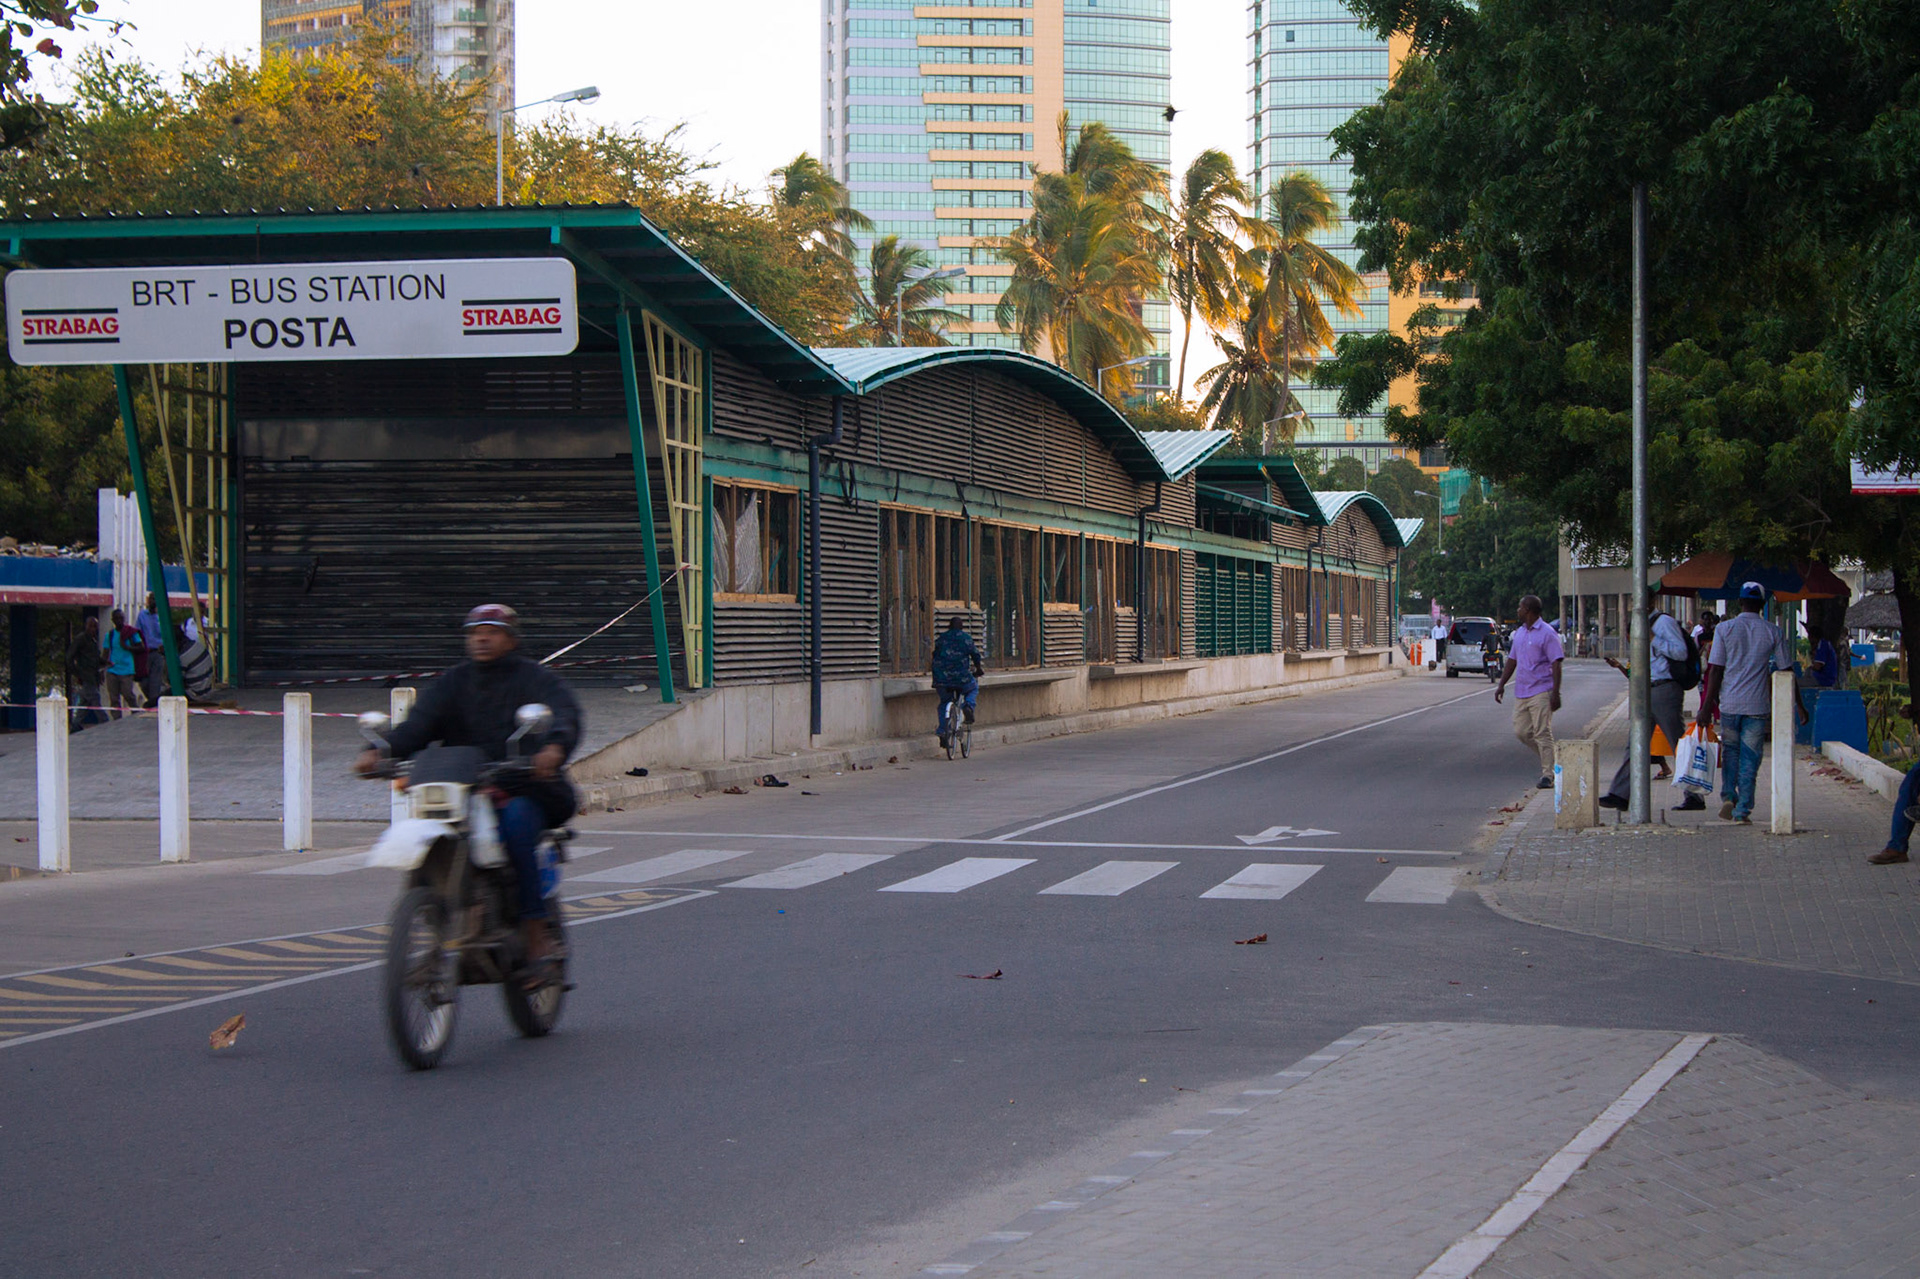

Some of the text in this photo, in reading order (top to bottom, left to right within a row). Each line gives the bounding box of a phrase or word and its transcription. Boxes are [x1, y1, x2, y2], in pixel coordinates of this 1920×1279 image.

[132, 279, 196, 307] BRT
[231, 277, 298, 305] BUS
[308, 273, 446, 303] STATION
[22, 316, 120, 337] STRABAG
[462, 306, 562, 327] STRABAG
[224, 316, 357, 350] POSTA
